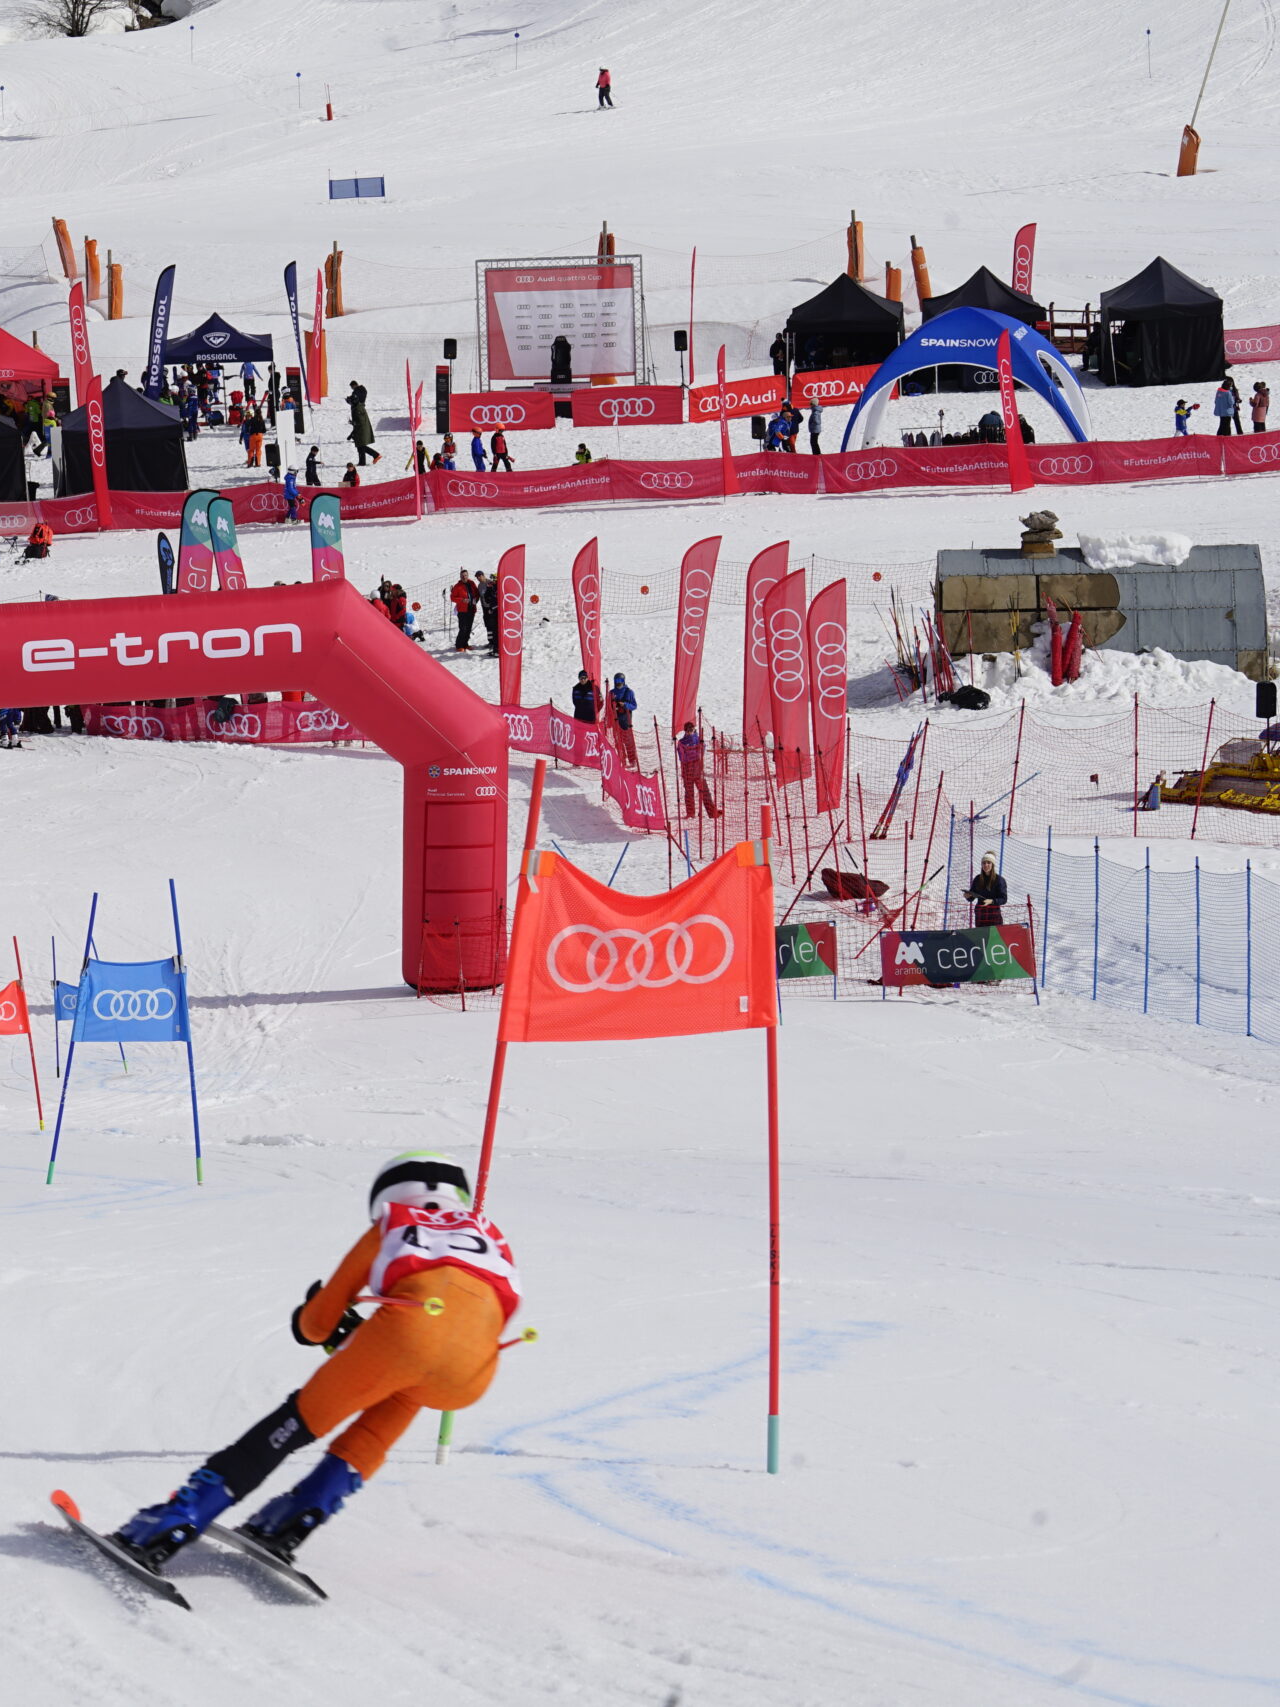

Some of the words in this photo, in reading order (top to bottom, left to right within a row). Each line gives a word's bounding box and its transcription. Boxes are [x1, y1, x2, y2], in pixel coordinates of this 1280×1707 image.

[150, 295, 168, 387] ROSSIGNOL
[920, 338, 999, 348] SPAINSNOW
[196, 353, 238, 361] ROSSIGNOL
[739, 389, 777, 407] Audi
[736, 467, 809, 480] utureIsAnAttitude
[523, 475, 611, 494] #FutureIsAnAttitude
[340, 492, 415, 511] utureIsAnAttitude
[135, 508, 181, 518] #FutureIsA
[22, 622, 302, 673] e-tron
[443, 766, 498, 776] SPAINSNOW
[778, 935, 825, 965] rler
[937, 938, 1019, 969] cerler
[894, 965, 927, 976] aramon
